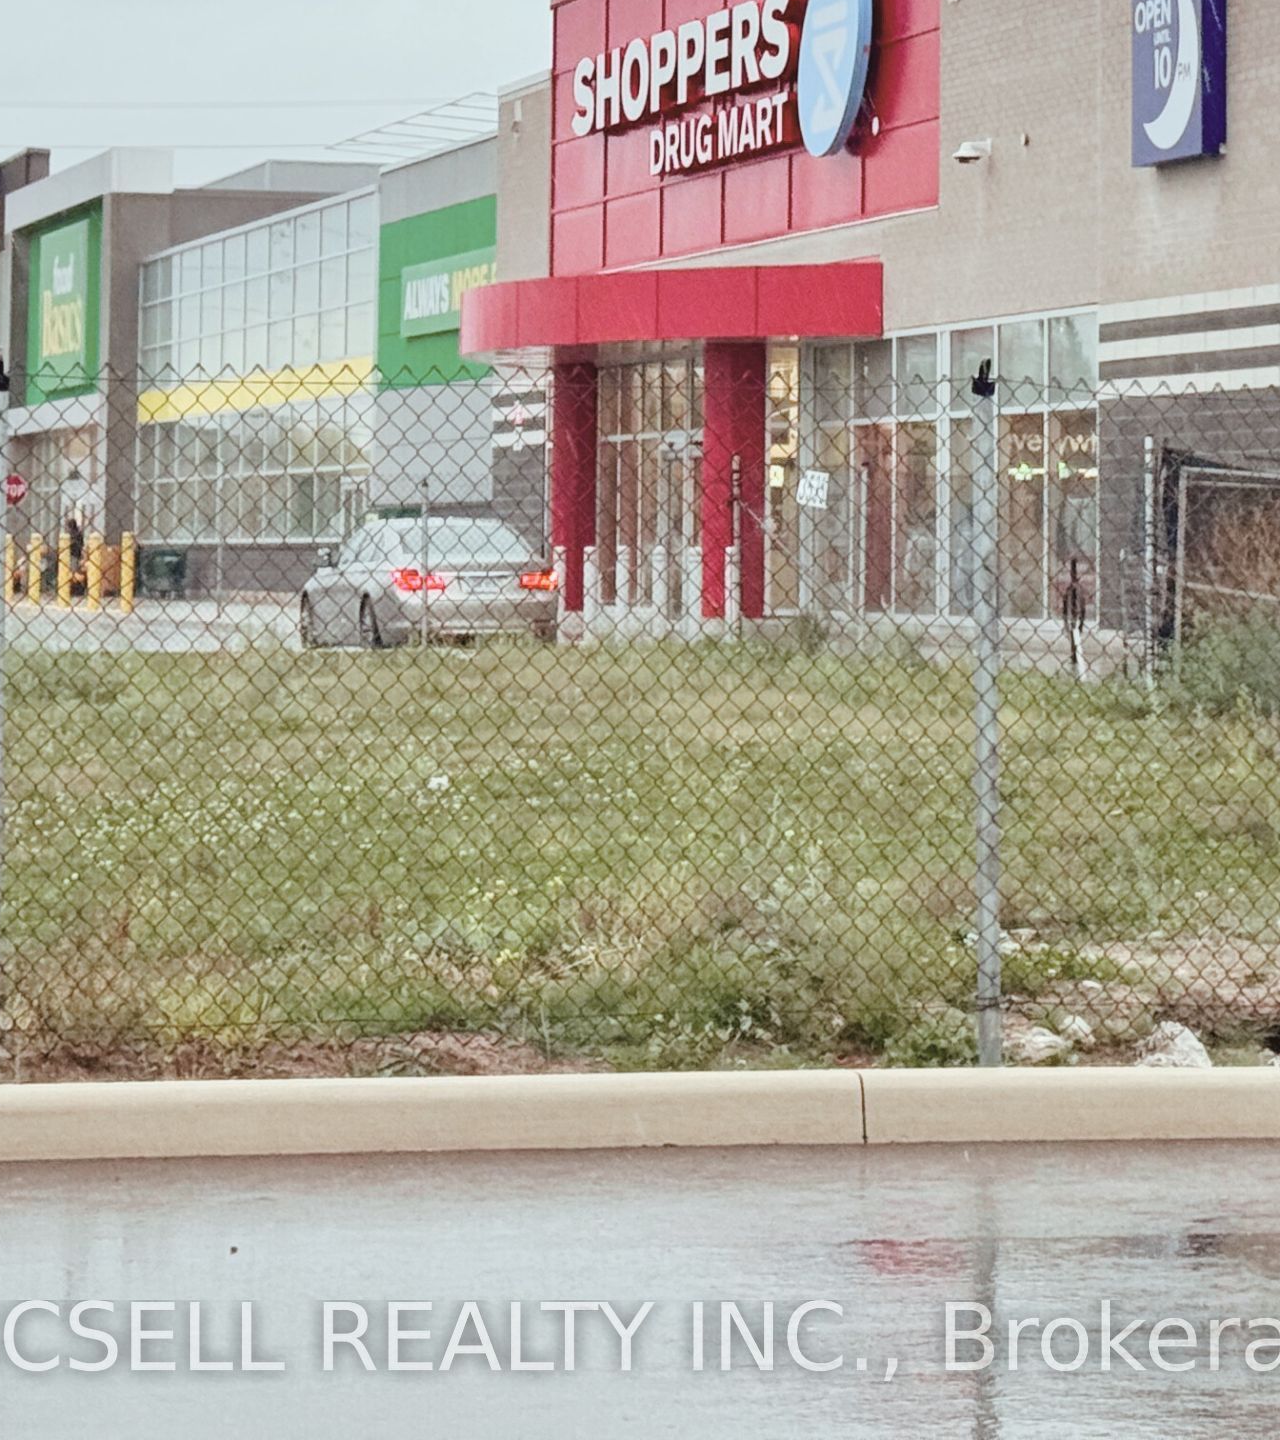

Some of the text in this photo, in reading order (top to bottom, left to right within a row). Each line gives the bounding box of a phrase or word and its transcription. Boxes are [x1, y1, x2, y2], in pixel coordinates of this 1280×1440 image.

[1154, 46, 1172, 90] 10
[649, 91, 789, 177] DRUG MART
[404, 272, 450, 321] ALWAYS
